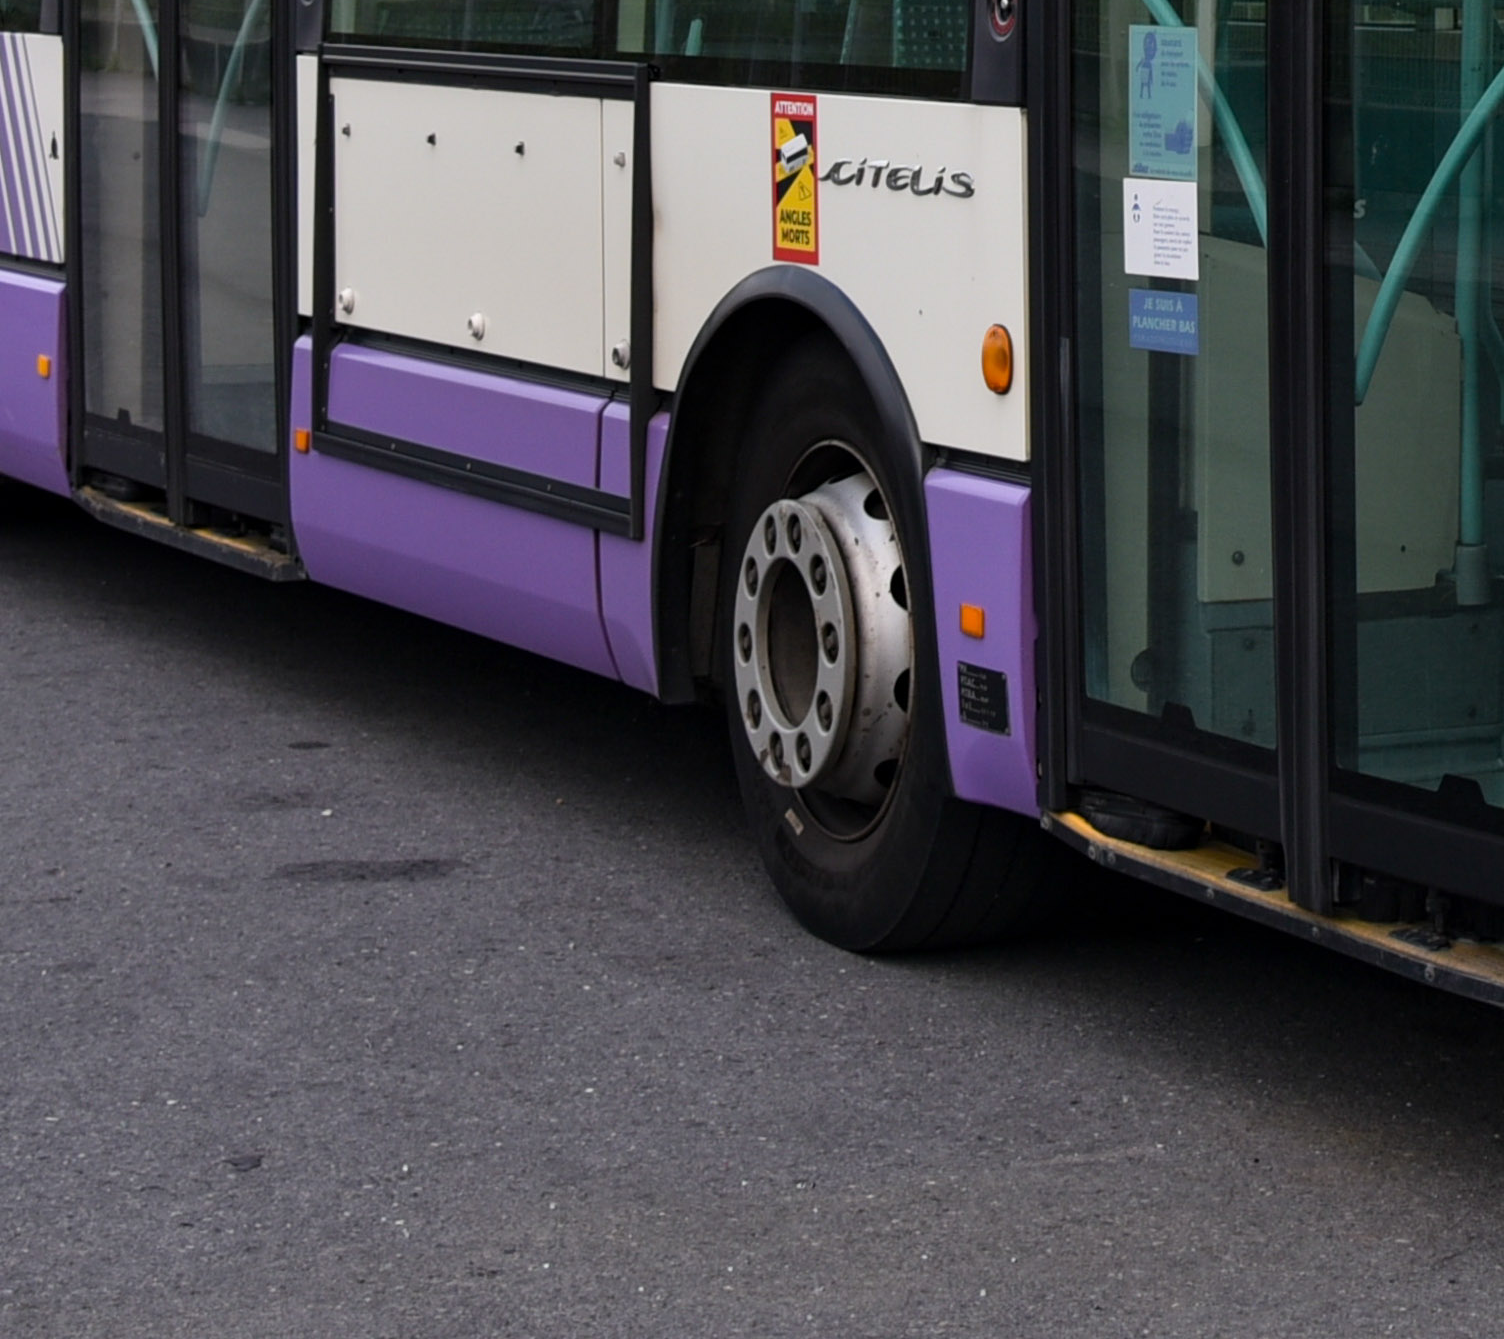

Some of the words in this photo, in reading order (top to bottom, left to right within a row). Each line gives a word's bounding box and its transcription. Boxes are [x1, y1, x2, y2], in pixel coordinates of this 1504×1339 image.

[774, 100, 814, 116] ATTENTION
[779, 208, 812, 227] ANGLES
[781, 227, 811, 246] MORTS
[1143, 297, 1153, 310] JE
[1155, 298, 1174, 312] SUIS
[1132, 315, 1177, 332] PLANCHER
[1178, 320, 1196, 334] BAS
